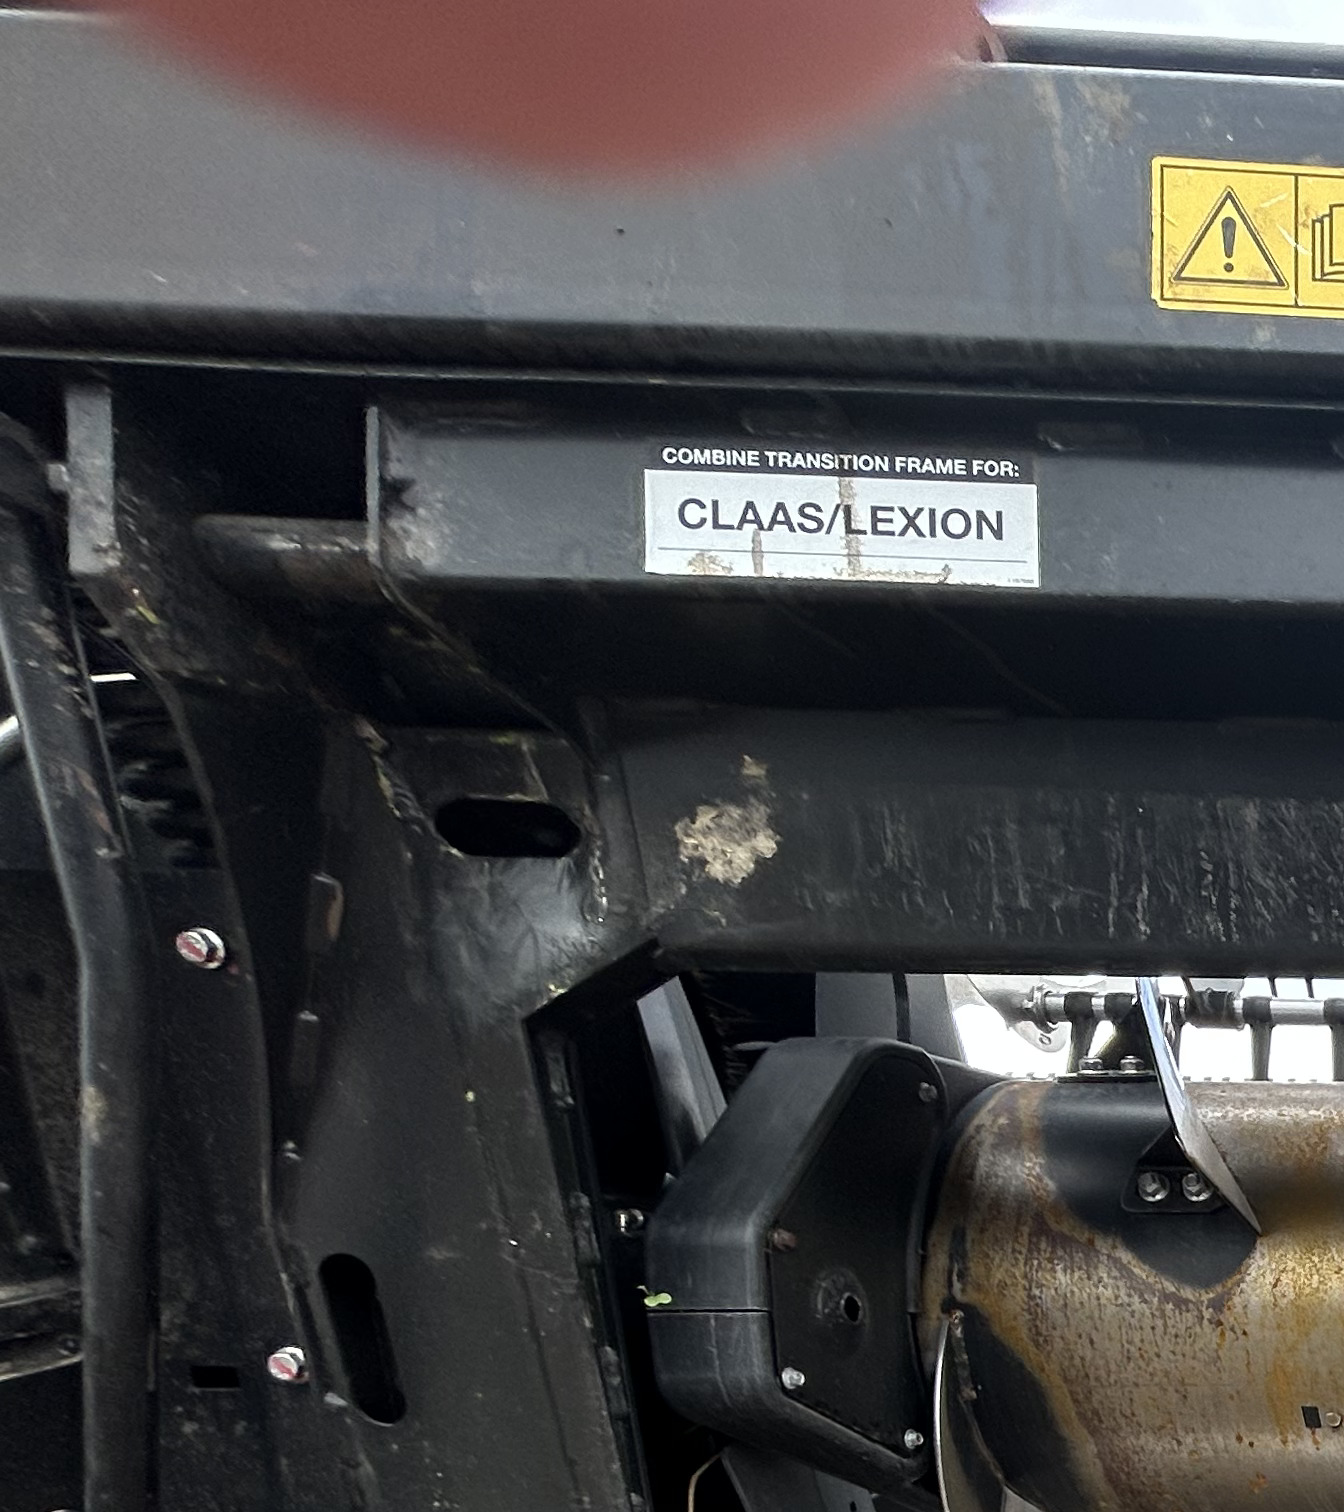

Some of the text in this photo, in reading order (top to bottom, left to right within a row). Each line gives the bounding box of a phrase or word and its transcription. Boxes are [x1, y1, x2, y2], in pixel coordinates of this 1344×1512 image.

[661, 446, 1020, 477] COMBINE TRANSITION FRAME FOR:
[677, 497, 1003, 541] CLAAS/LEXION
